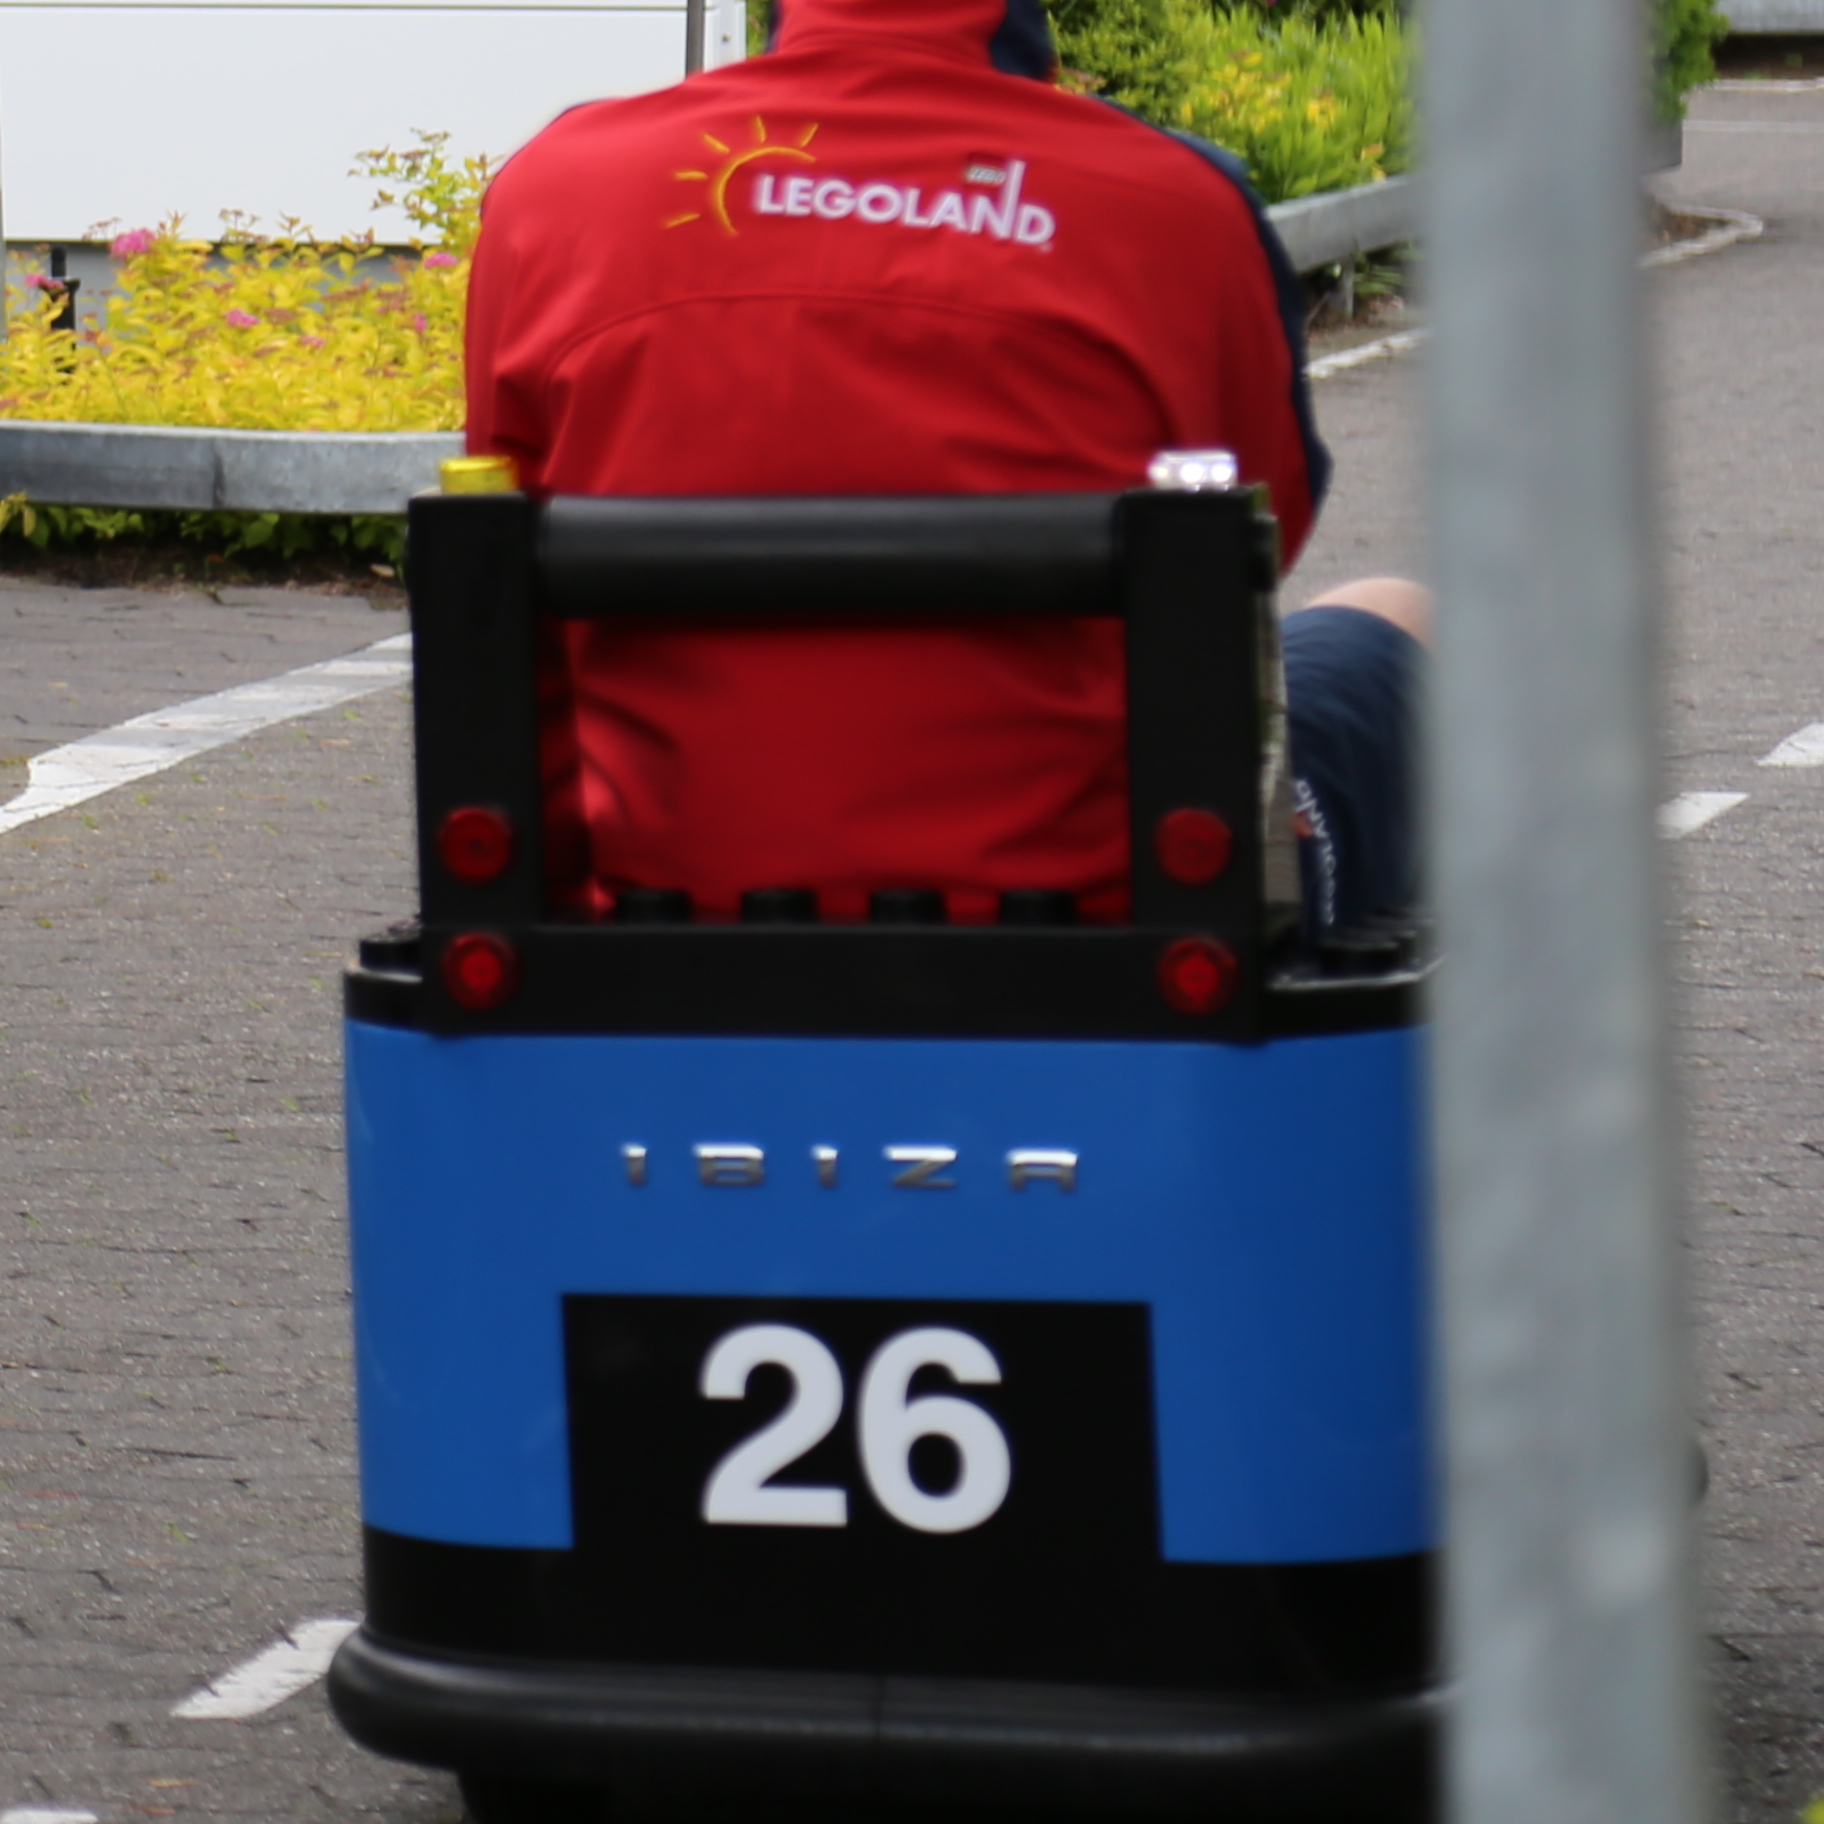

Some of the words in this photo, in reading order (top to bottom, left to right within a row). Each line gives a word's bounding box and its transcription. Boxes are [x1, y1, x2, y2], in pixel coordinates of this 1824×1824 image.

[756, 160, 1055, 244] LEGOLAND
[624, 1143, 1079, 1191] IBIZA
[698, 1322, 1013, 1536] 26
